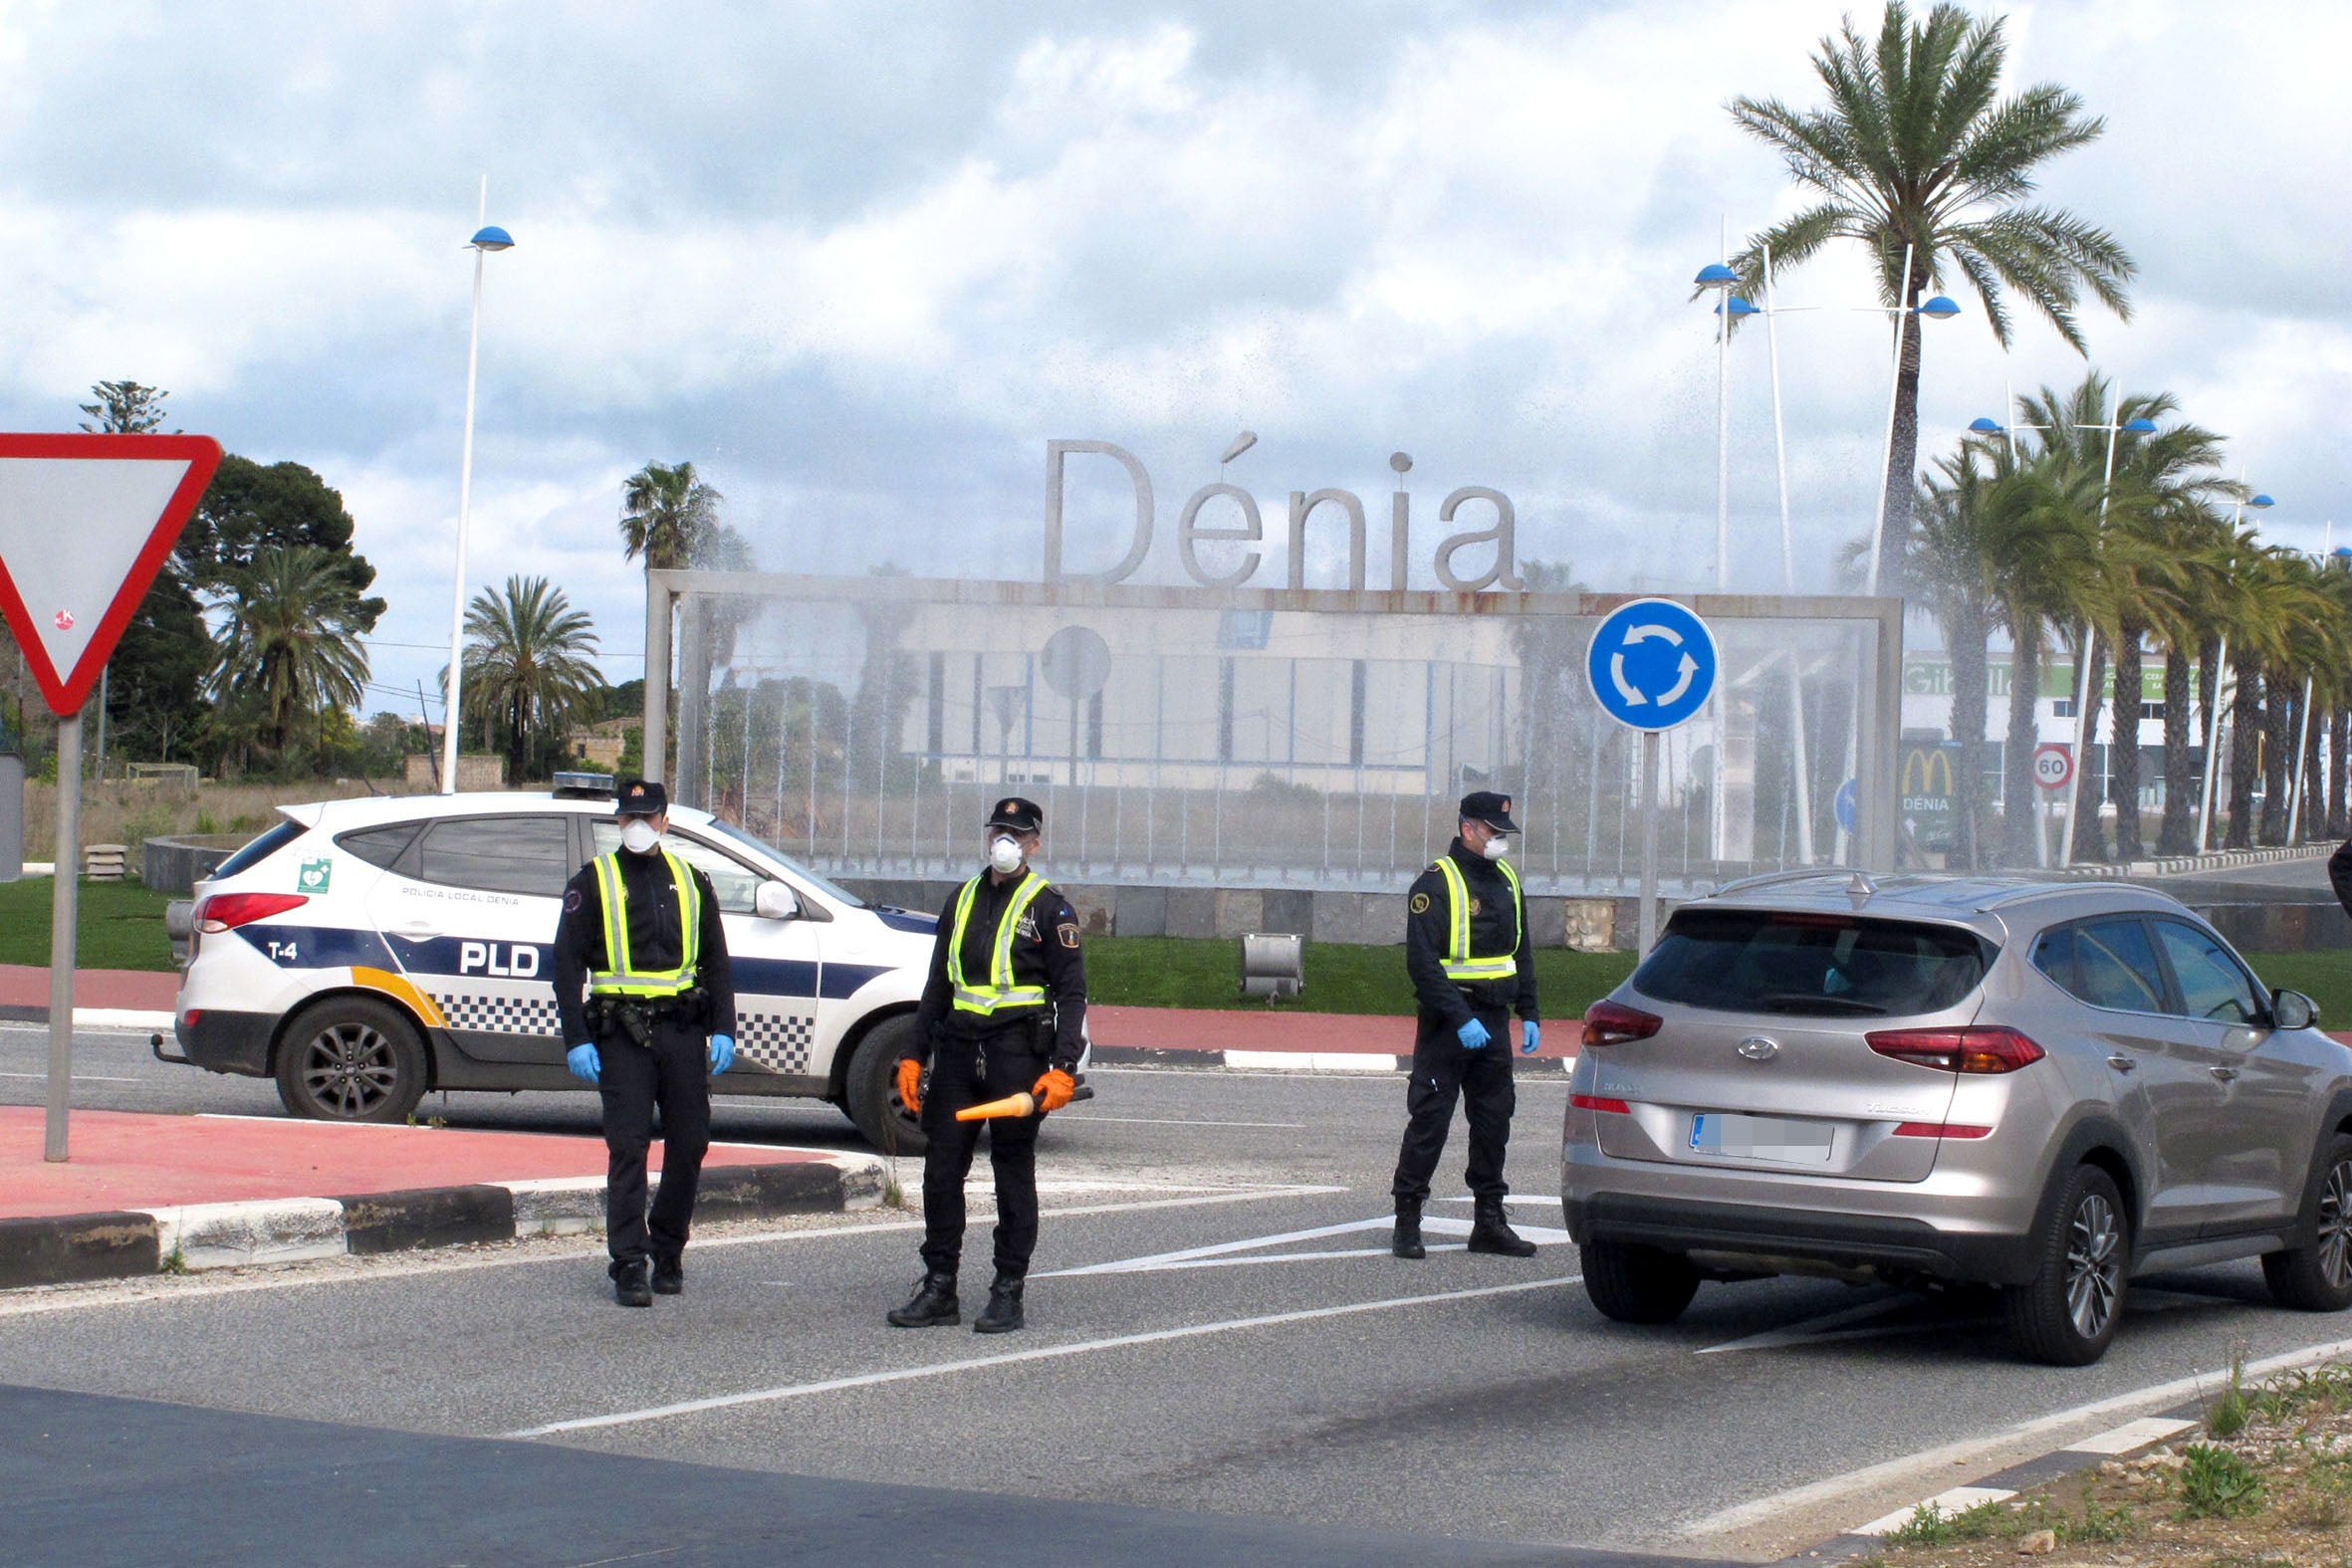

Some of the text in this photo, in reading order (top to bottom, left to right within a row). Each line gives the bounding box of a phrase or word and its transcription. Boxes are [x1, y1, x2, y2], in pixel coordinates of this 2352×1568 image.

[1045, 430, 1523, 592] Dénia
[2038, 759, 2064, 776] 60
[448, 892, 484, 903] LOCAL
[268, 942, 298, 961] T-4
[459, 941, 541, 979] PLD
